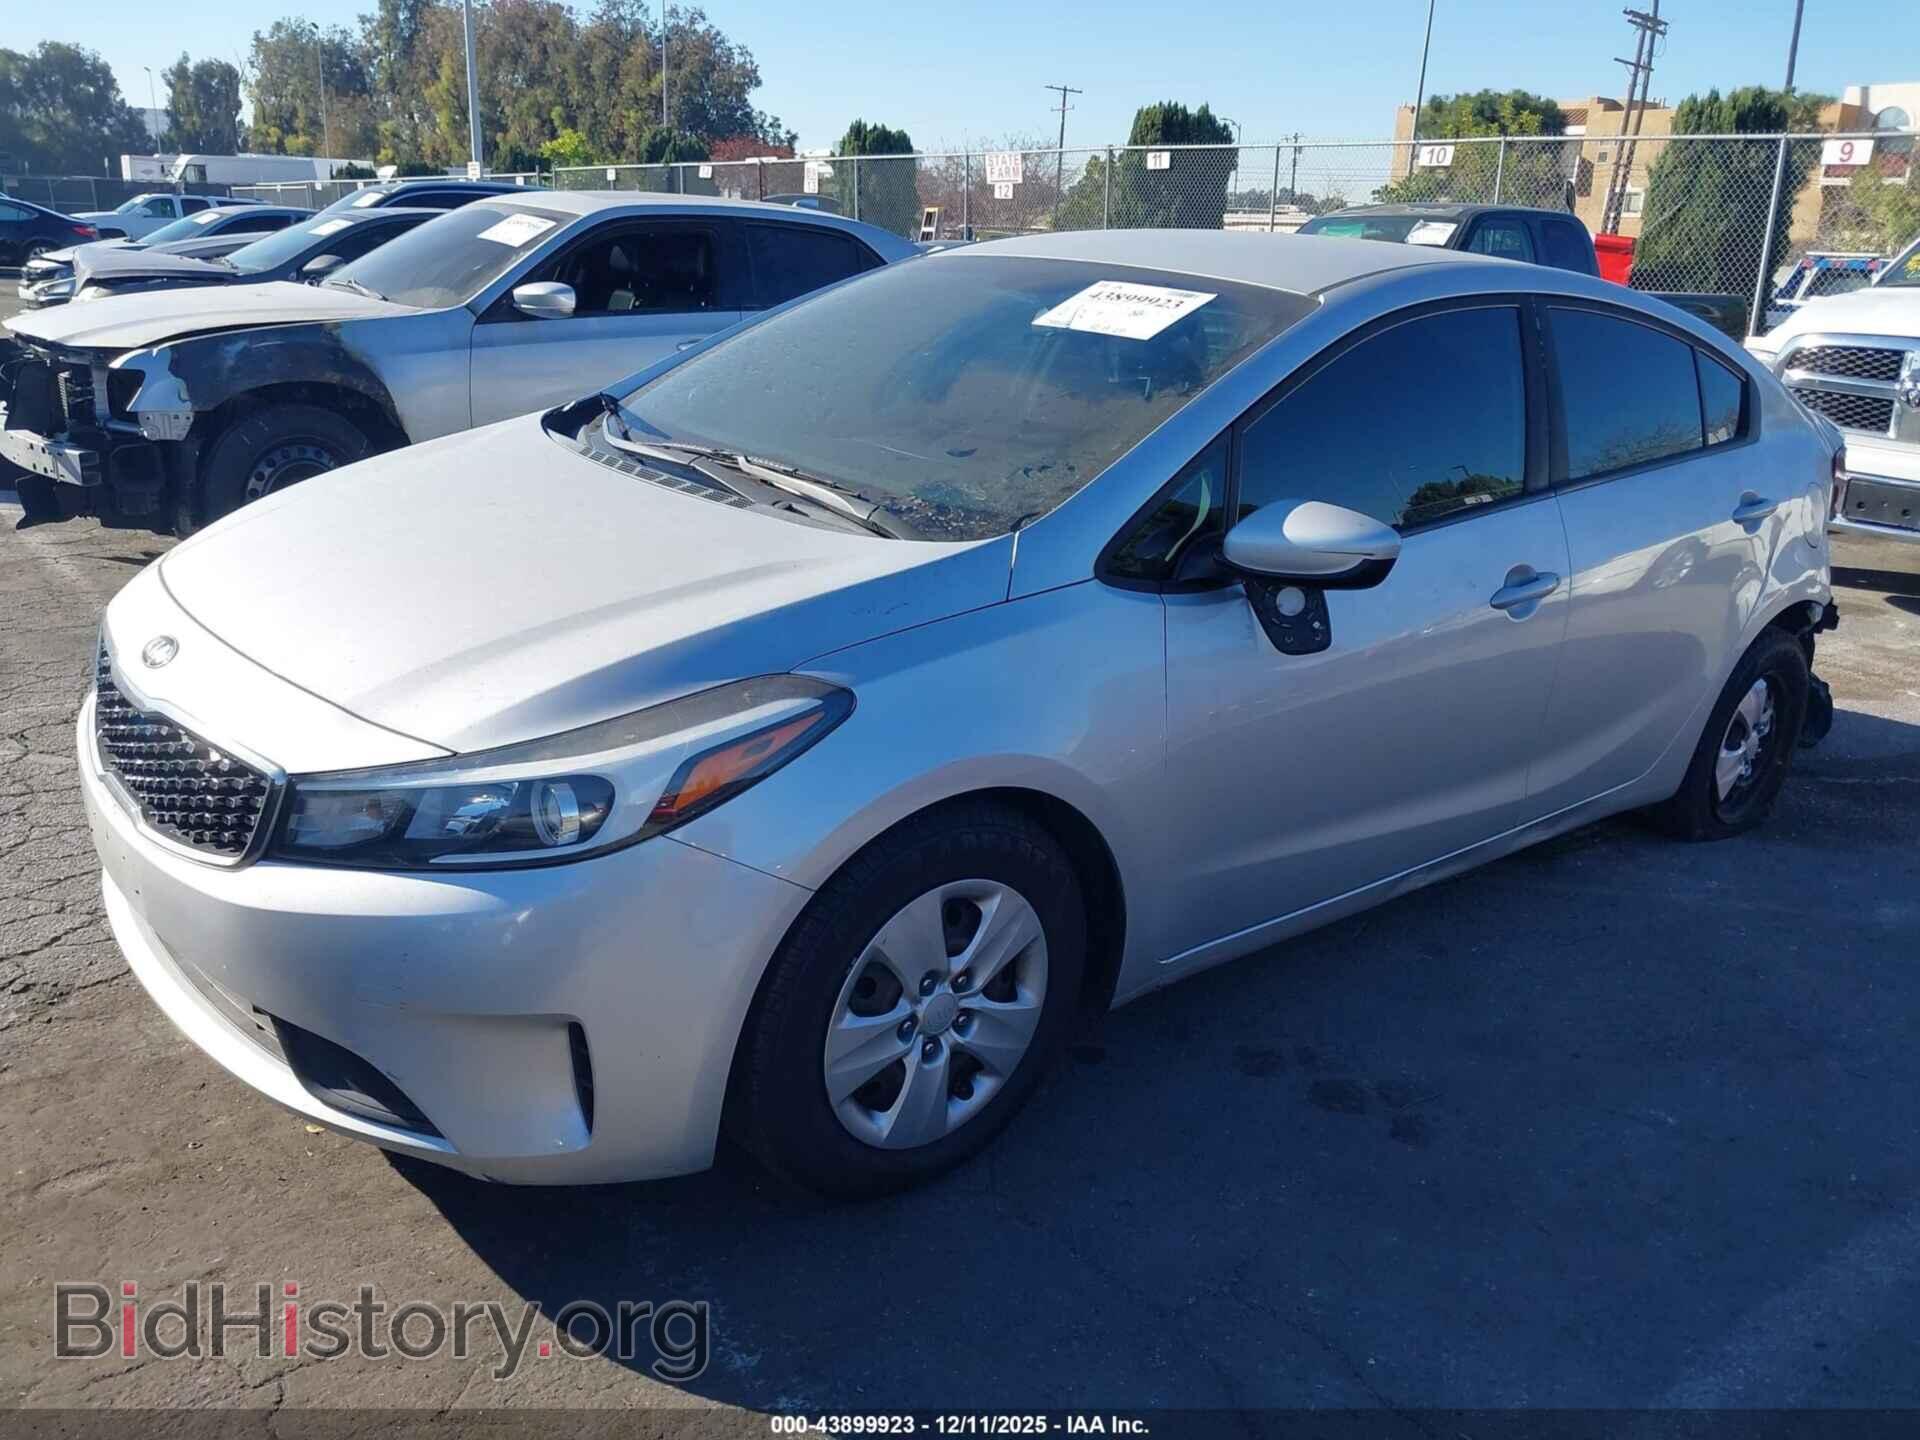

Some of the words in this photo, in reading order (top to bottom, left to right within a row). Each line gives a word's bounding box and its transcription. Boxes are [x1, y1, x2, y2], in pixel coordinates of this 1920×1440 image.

[1427, 147, 1447, 164] 10
[1839, 141, 1854, 162] 9
[987, 154, 1020, 167] STATE
[1152, 153, 1162, 168] 11
[989, 166, 1020, 178] FARM
[998, 184, 1010, 197] 12
